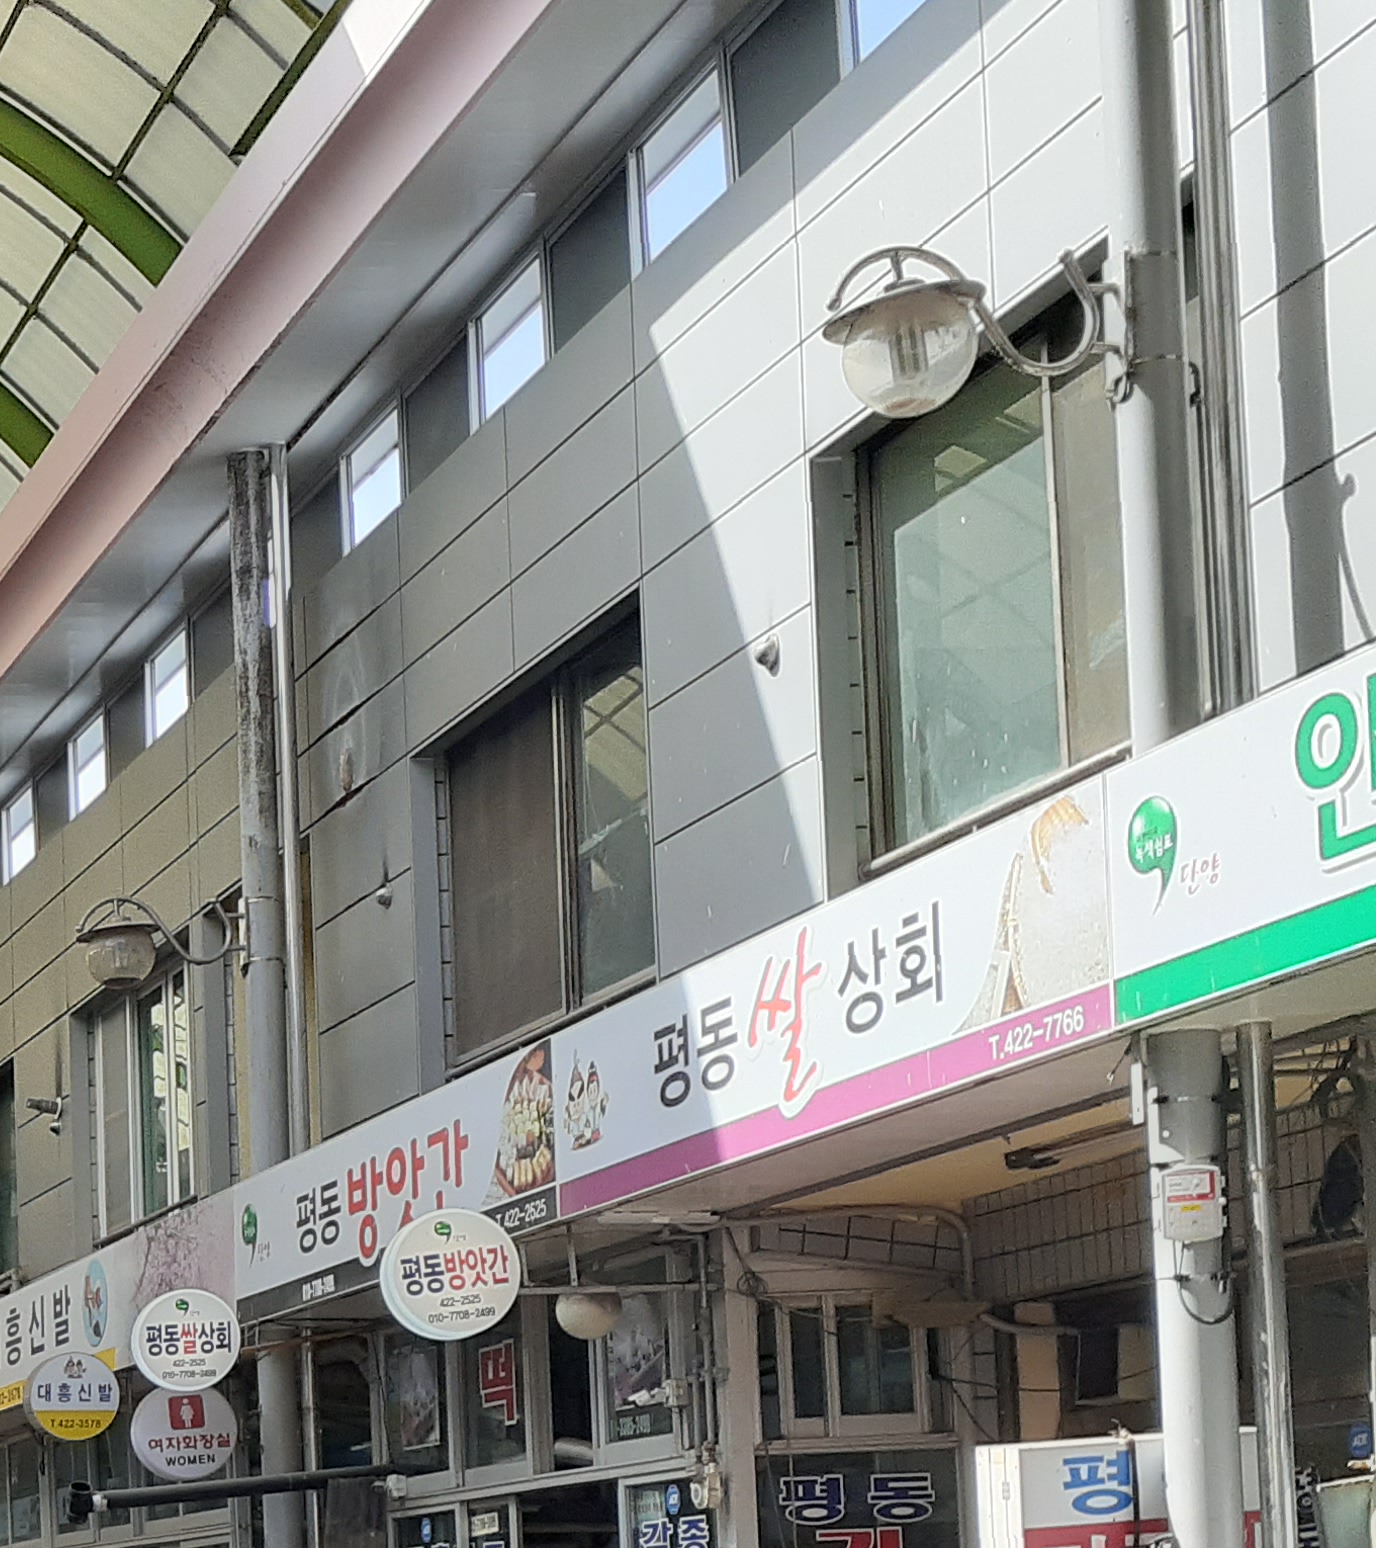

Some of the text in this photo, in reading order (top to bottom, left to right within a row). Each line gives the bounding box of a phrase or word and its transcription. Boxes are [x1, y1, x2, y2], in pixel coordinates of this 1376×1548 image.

[1180, 852, 1220, 895] 단양
[988, 1006, 1086, 1064] T.422-7766
[440, 1295, 482, 1307] 422-2525
[37, 1382, 113, 1403] 대흥신발
[479, 1339, 517, 1425] 떡
[149, 1433, 231, 1453] 여자화장실
[165, 1453, 217, 1467] WOMEN
[779, 1472, 936, 1526] 평동
